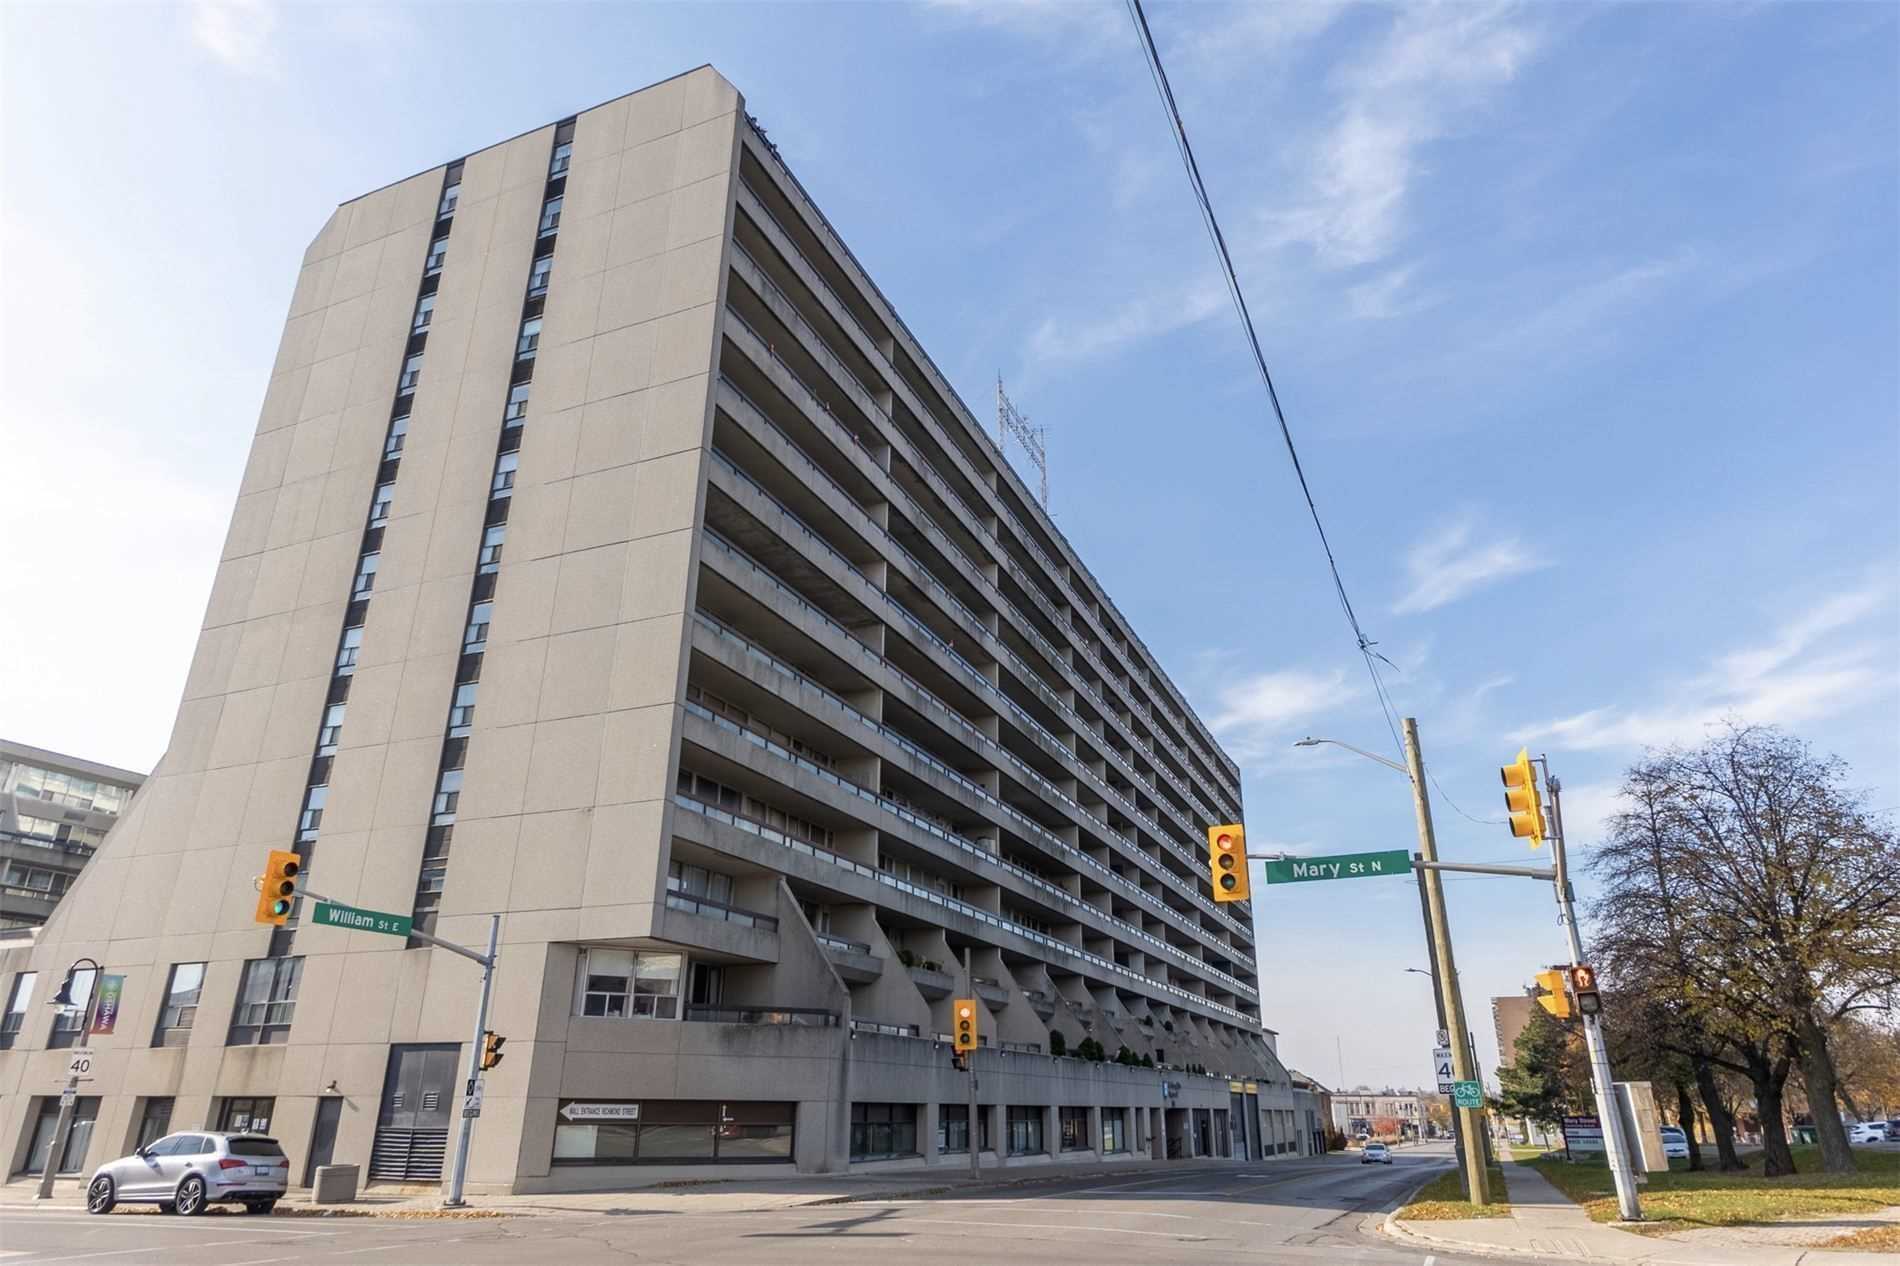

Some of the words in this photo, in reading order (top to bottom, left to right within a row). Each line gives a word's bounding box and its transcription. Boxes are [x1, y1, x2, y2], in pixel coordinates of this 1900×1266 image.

[1292, 862, 1340, 878] Mary
[1349, 862, 1365, 874] St
[1371, 861, 1382, 872] N
[328, 907, 374, 928] William
[377, 920, 389, 931] St
[392, 922, 400, 932] E
[70, 1059, 90, 1073] 40
[1456, 1098, 1479, 1106] ROUTE
